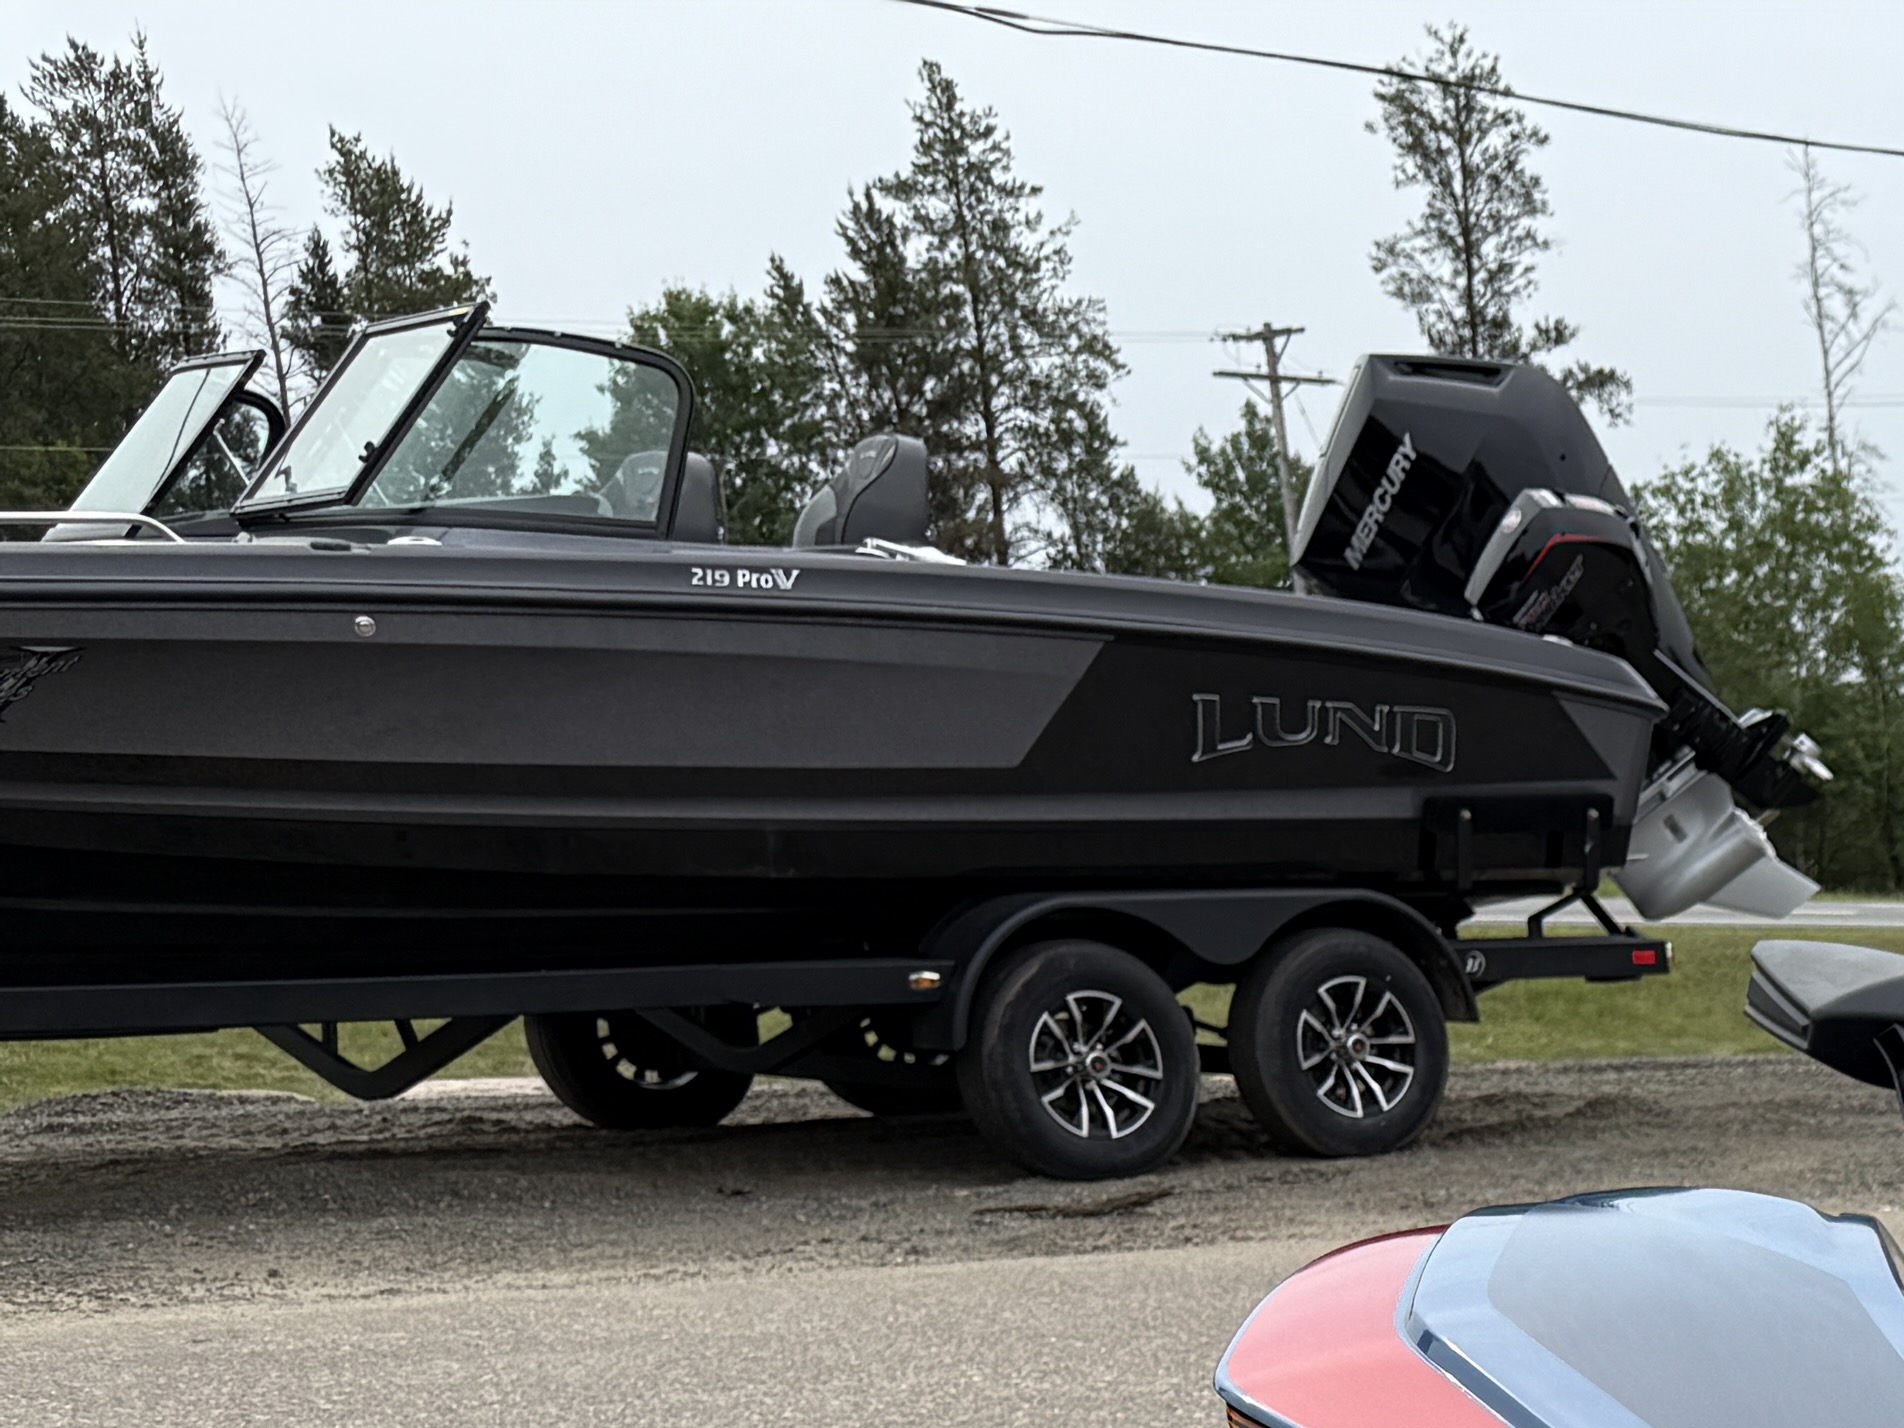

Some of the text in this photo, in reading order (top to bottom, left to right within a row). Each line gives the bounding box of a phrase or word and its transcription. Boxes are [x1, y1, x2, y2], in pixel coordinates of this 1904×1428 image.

[1343, 432, 1418, 571] MERCURY
[691, 567, 731, 588] 219
[1191, 693, 1457, 773] LUND
